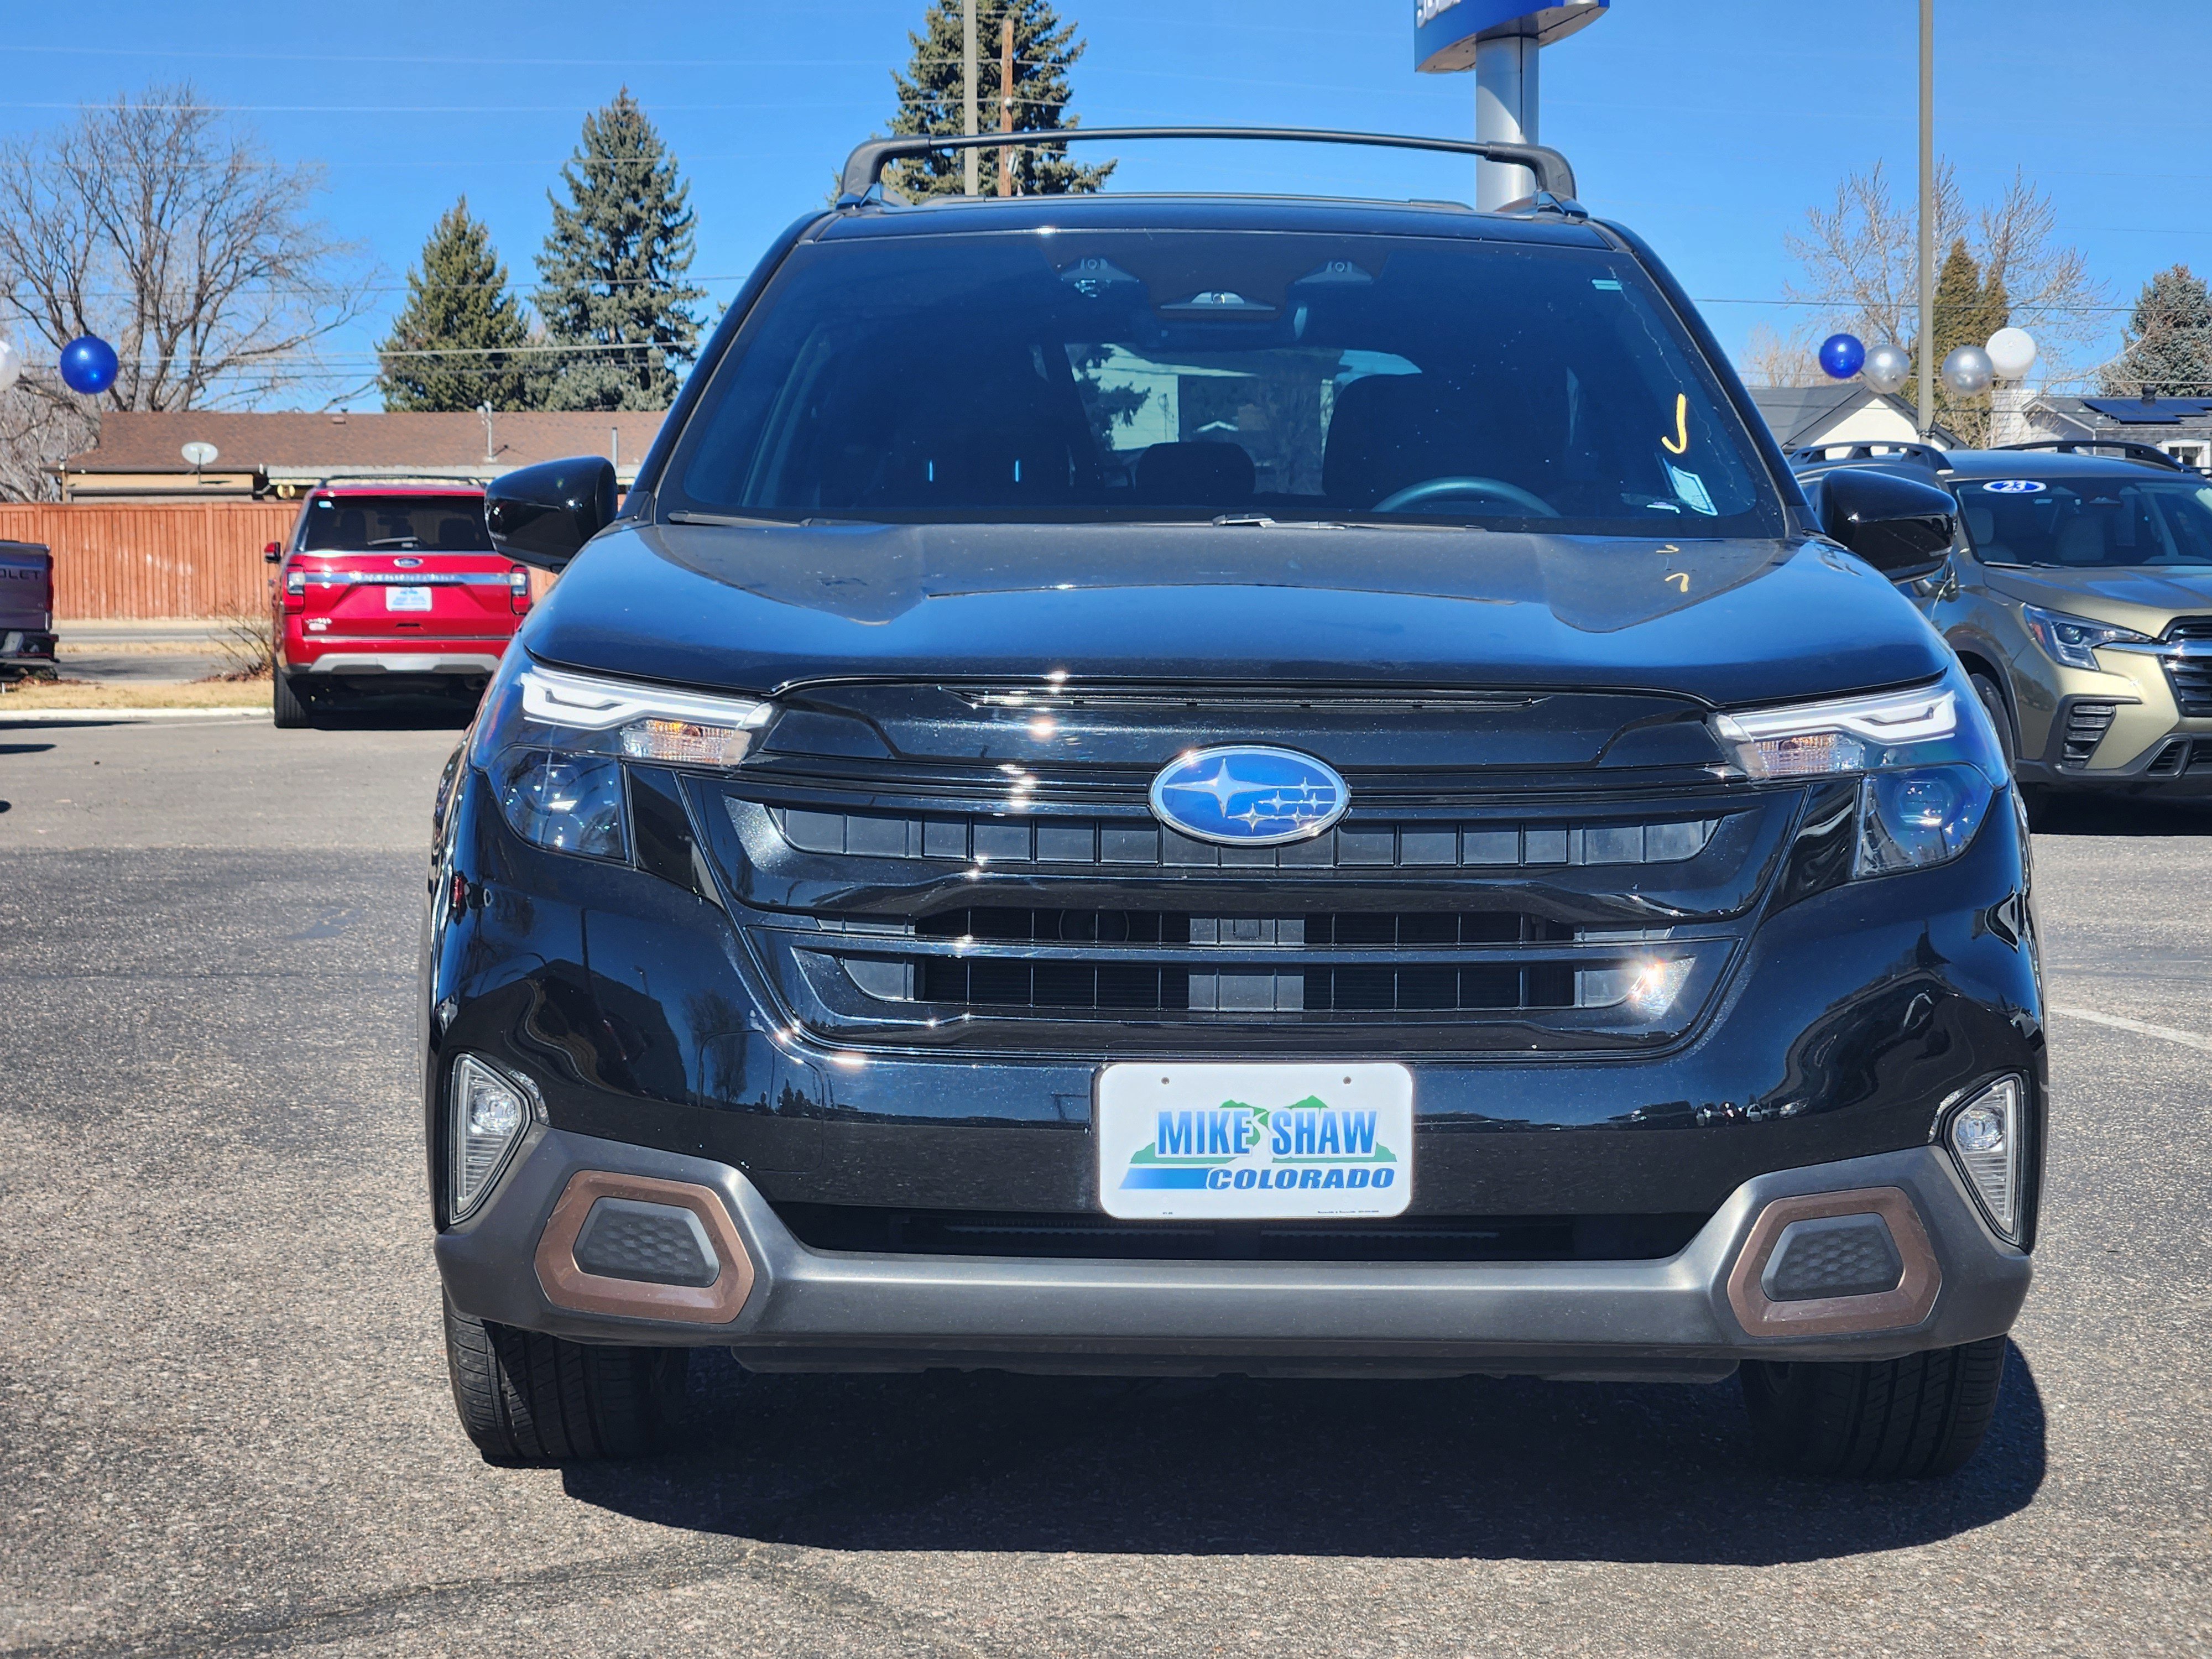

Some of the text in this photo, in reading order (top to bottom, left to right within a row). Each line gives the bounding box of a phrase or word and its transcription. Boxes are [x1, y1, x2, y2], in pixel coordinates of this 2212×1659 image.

[1999, 481, 2027, 492] 23
[1158, 1110, 1377, 1155] MIKE SHAW
[1208, 1167, 1395, 1190] COLORADO
